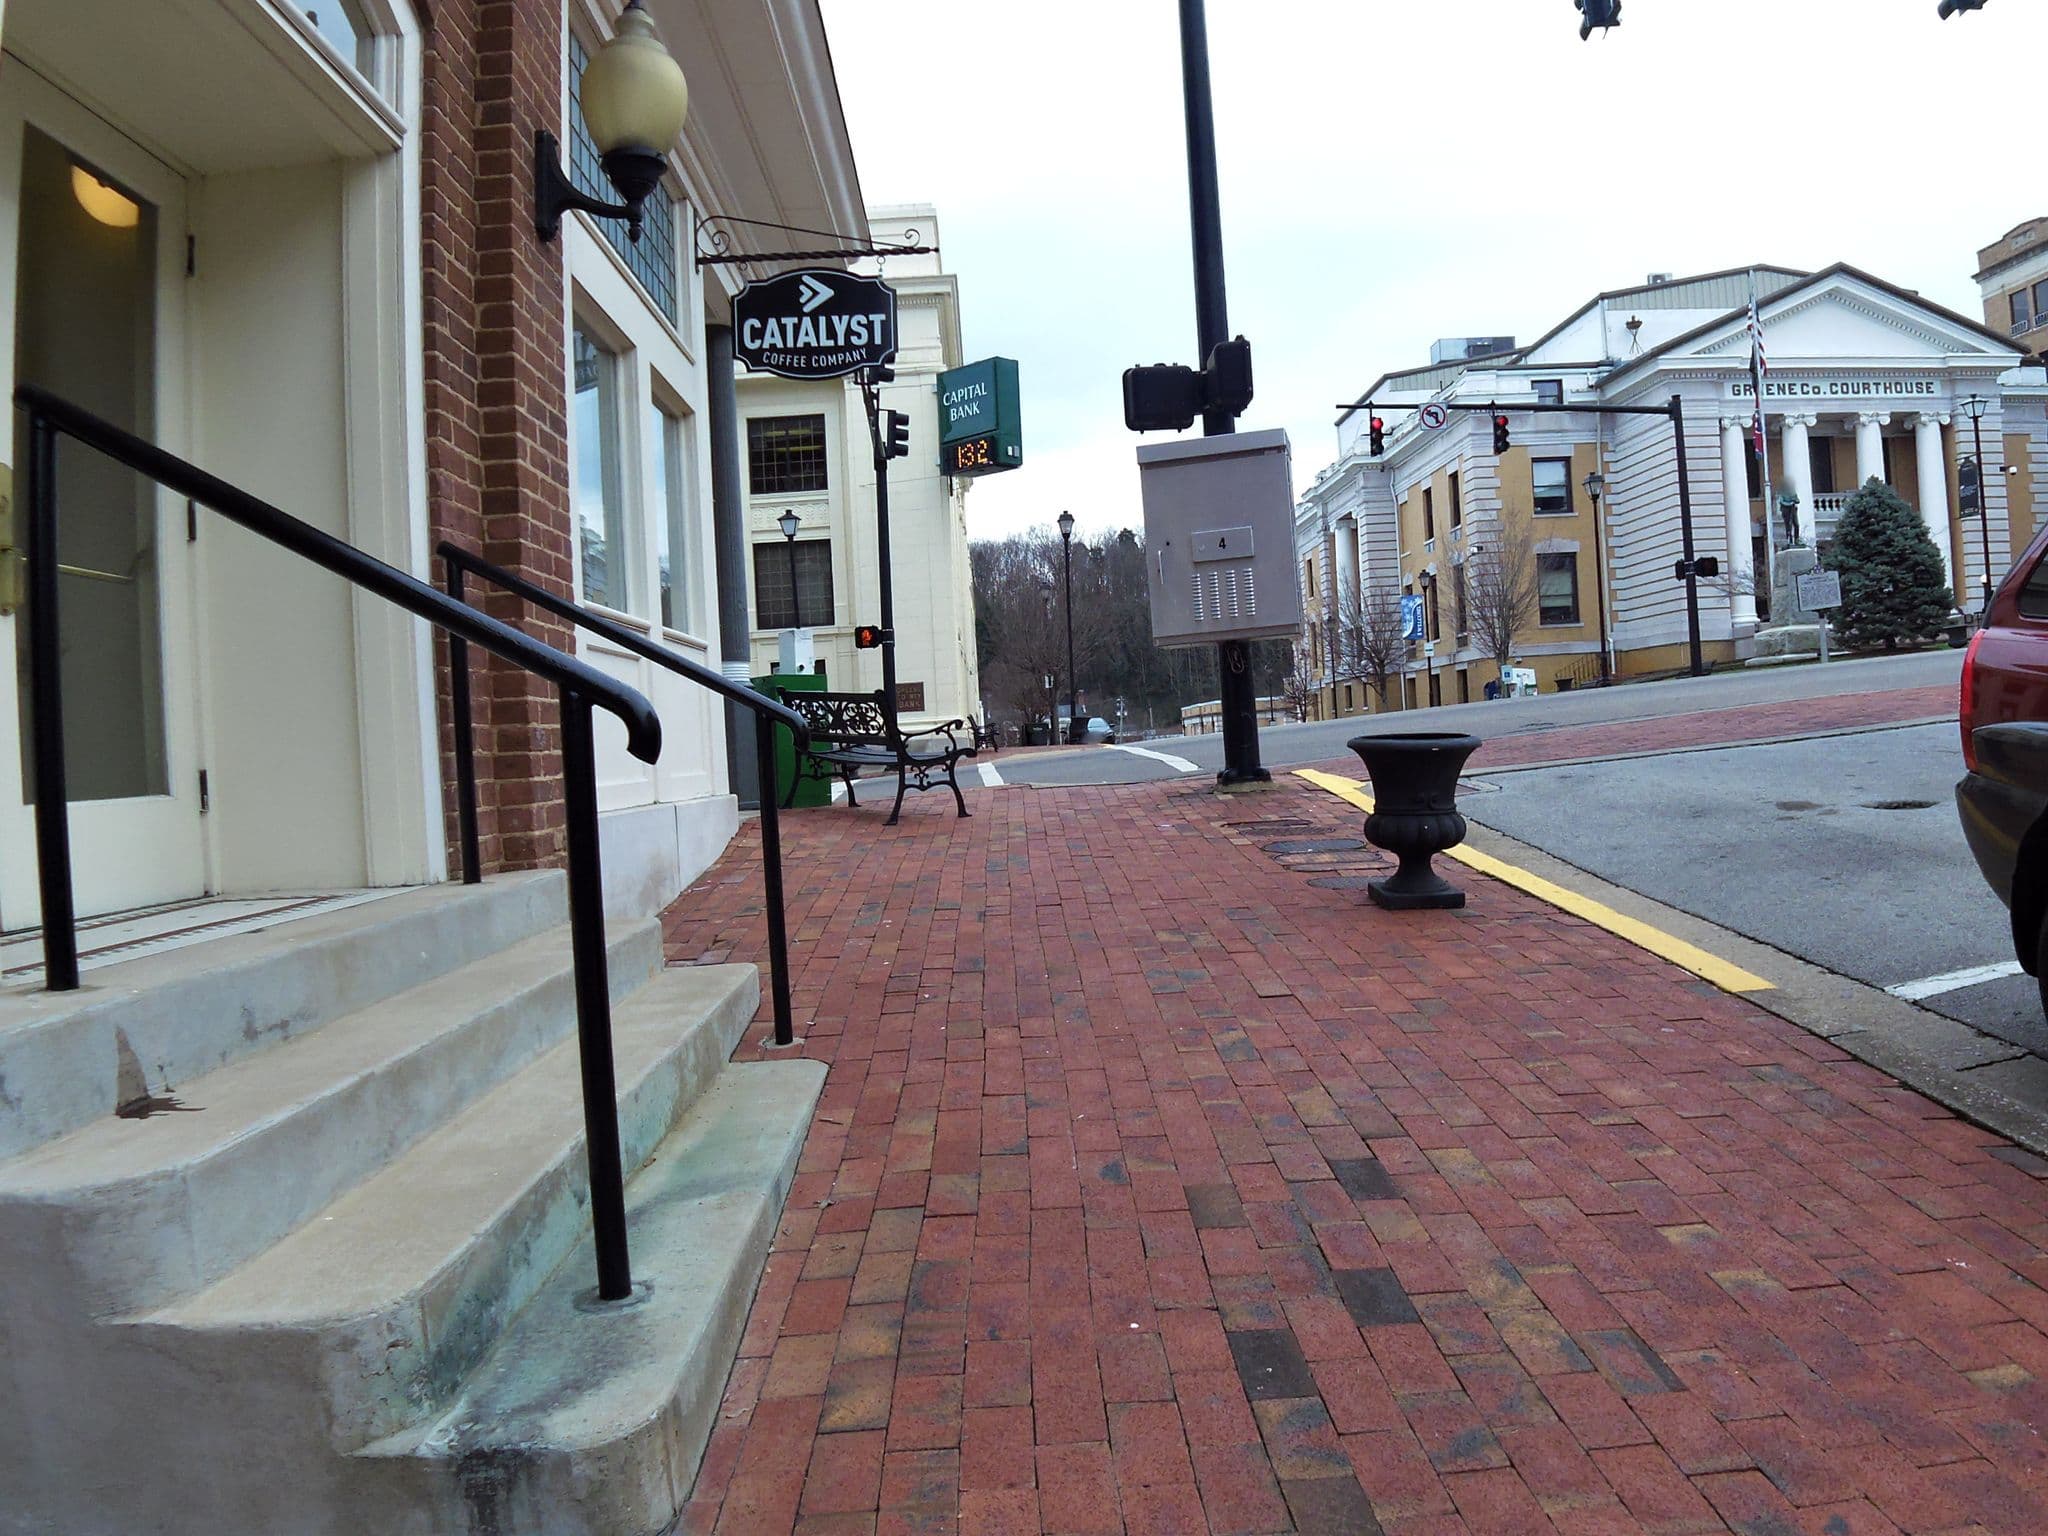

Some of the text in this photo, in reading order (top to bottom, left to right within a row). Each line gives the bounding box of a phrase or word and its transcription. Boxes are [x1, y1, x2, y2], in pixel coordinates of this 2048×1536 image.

[743, 314, 886, 350] CATALYST
[762, 348, 868, 368] COFFEE COMPANY
[943, 382, 988, 406] CAPITAL
[1732, 382, 1797, 396] GRENE
[1829, 382, 1935, 395] COURTHOUSE
[950, 401, 980, 421] BANK
[1219, 537, 1226, 549] 4
